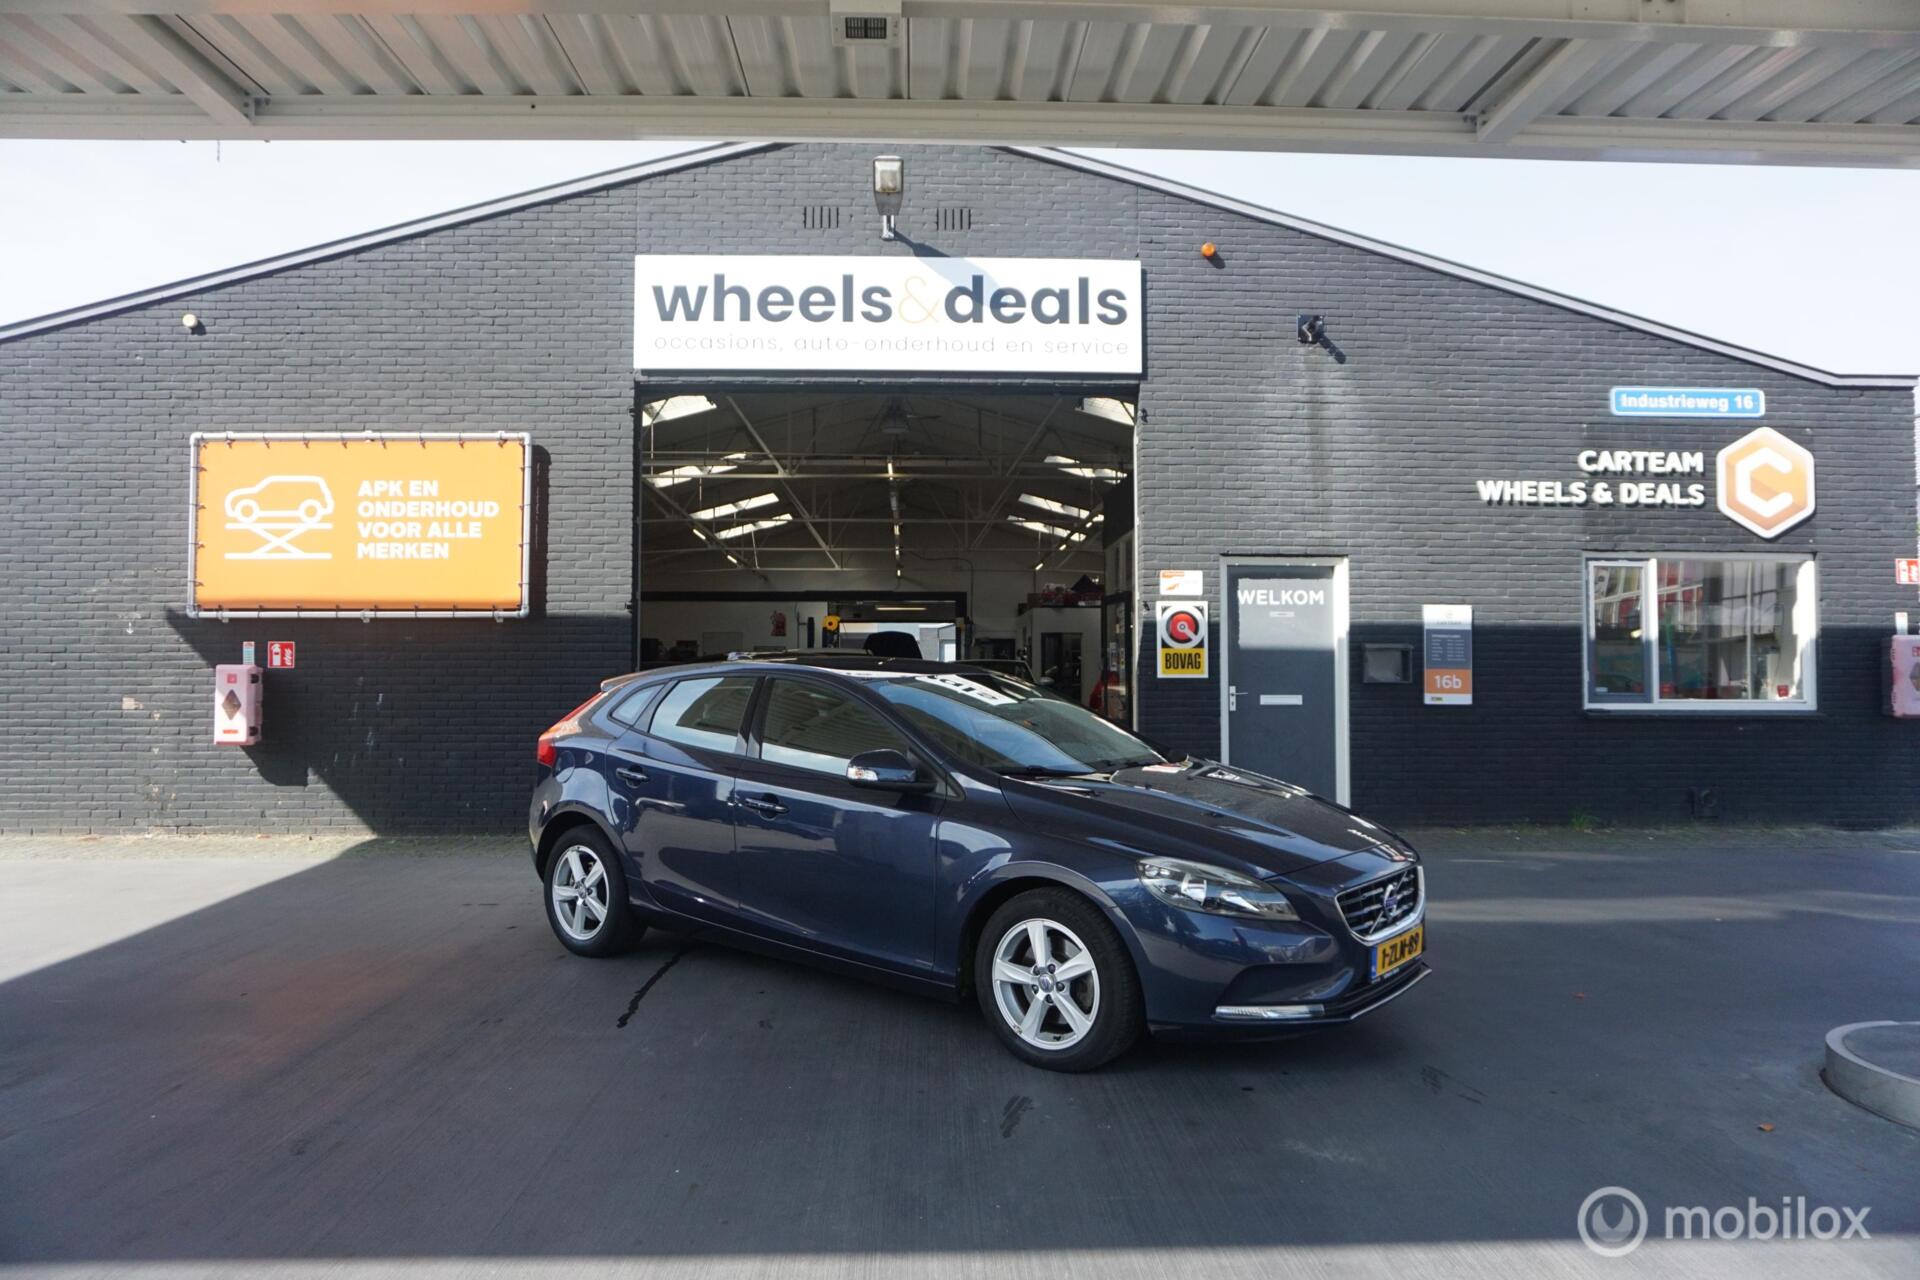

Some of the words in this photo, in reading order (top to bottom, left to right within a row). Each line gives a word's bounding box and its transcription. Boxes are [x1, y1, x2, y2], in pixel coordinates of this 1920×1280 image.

[654, 334, 784, 351] occasions,
[794, 336, 994, 353] auto-onderhoud
[1006, 340, 1033, 353] en
[1045, 338, 1129, 355] service
[1620, 393, 1728, 412] Industrieweg
[1734, 394, 1754, 409] 16
[1578, 450, 1704, 473] CARTEAM
[358, 480, 403, 497] APK
[409, 480, 438, 497] EN
[1476, 479, 1587, 503] WHEELS
[1592, 482, 1613, 504] &
[1620, 482, 1705, 505] DEALS
[357, 501, 500, 518] ONDERHOUD
[357, 522, 421, 538] VOOR
[427, 522, 482, 538] ALLE
[356, 542, 449, 559] MERKEN
[1237, 589, 1325, 606] WELKOM
[1165, 652, 1201, 670] BOVAG
[1434, 674, 1462, 689] 16b
